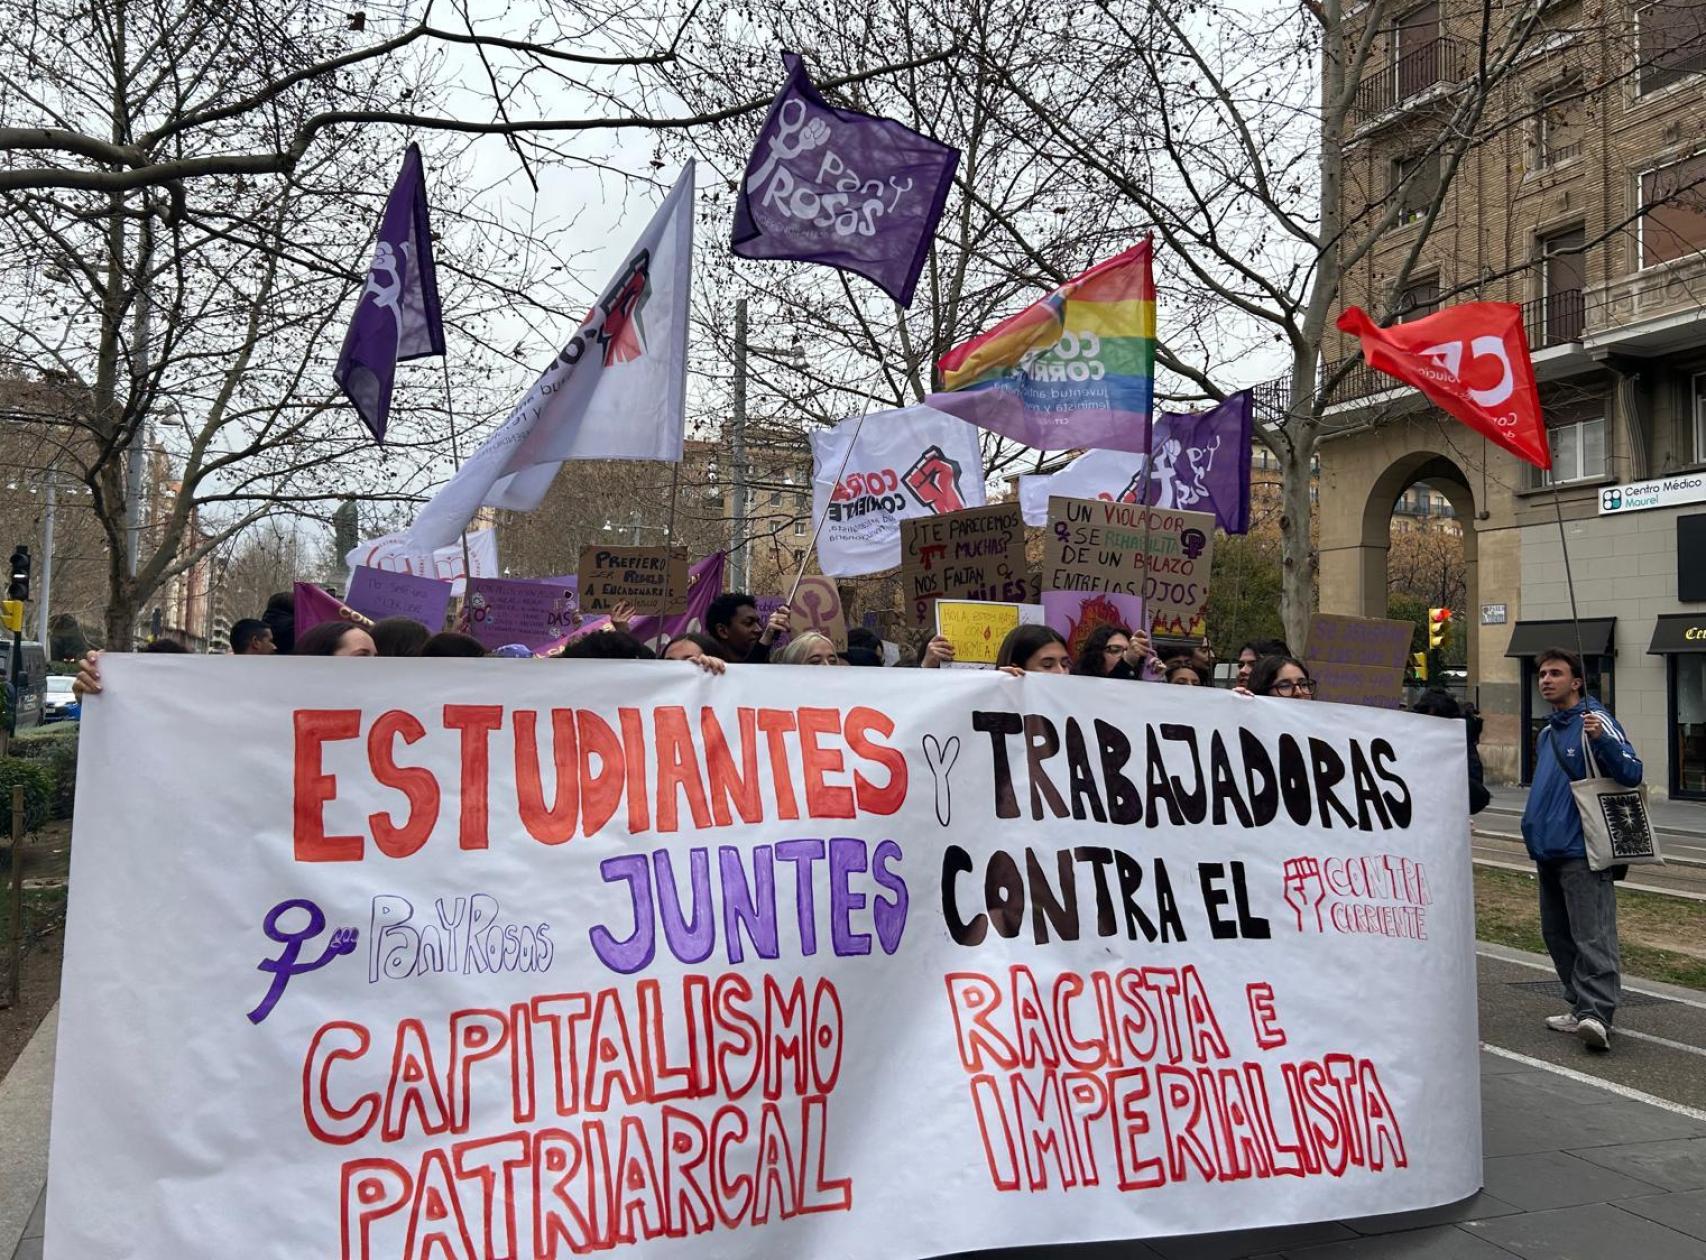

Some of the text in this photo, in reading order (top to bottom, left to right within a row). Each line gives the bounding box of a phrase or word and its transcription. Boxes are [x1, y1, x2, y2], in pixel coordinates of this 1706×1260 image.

[1624, 479, 1702, 497] Centro Médico
[1624, 495, 1659, 508] Maurel
[909, 512, 1018, 556] ¿TE PARECEMOS
[1066, 501, 1184, 532] UN VIOLADOR
[1074, 527, 1101, 546] SE
[914, 567, 984, 597] NOS FALTAN
[1061, 545, 1194, 577] DE UN BALAZO
[1052, 568, 1101, 592] ENTRE
[1141, 577, 1198, 606] OJOS
[293, 704, 1413, 862] ESTUDIANTES Y TRABAJADORAS
[1324, 854, 1433, 906] CONTRA
[588, 838, 1271, 975] JUNTES CONTRA EL
[1330, 901, 1428, 941] CORRIENTE
[945, 963, 1287, 1073] RACISTA E
[302, 972, 844, 1146] CAPITALISMO
[970, 1052, 1408, 1193] IMPERIALISTA
[339, 1094, 853, 1260] PATRIARCAL
